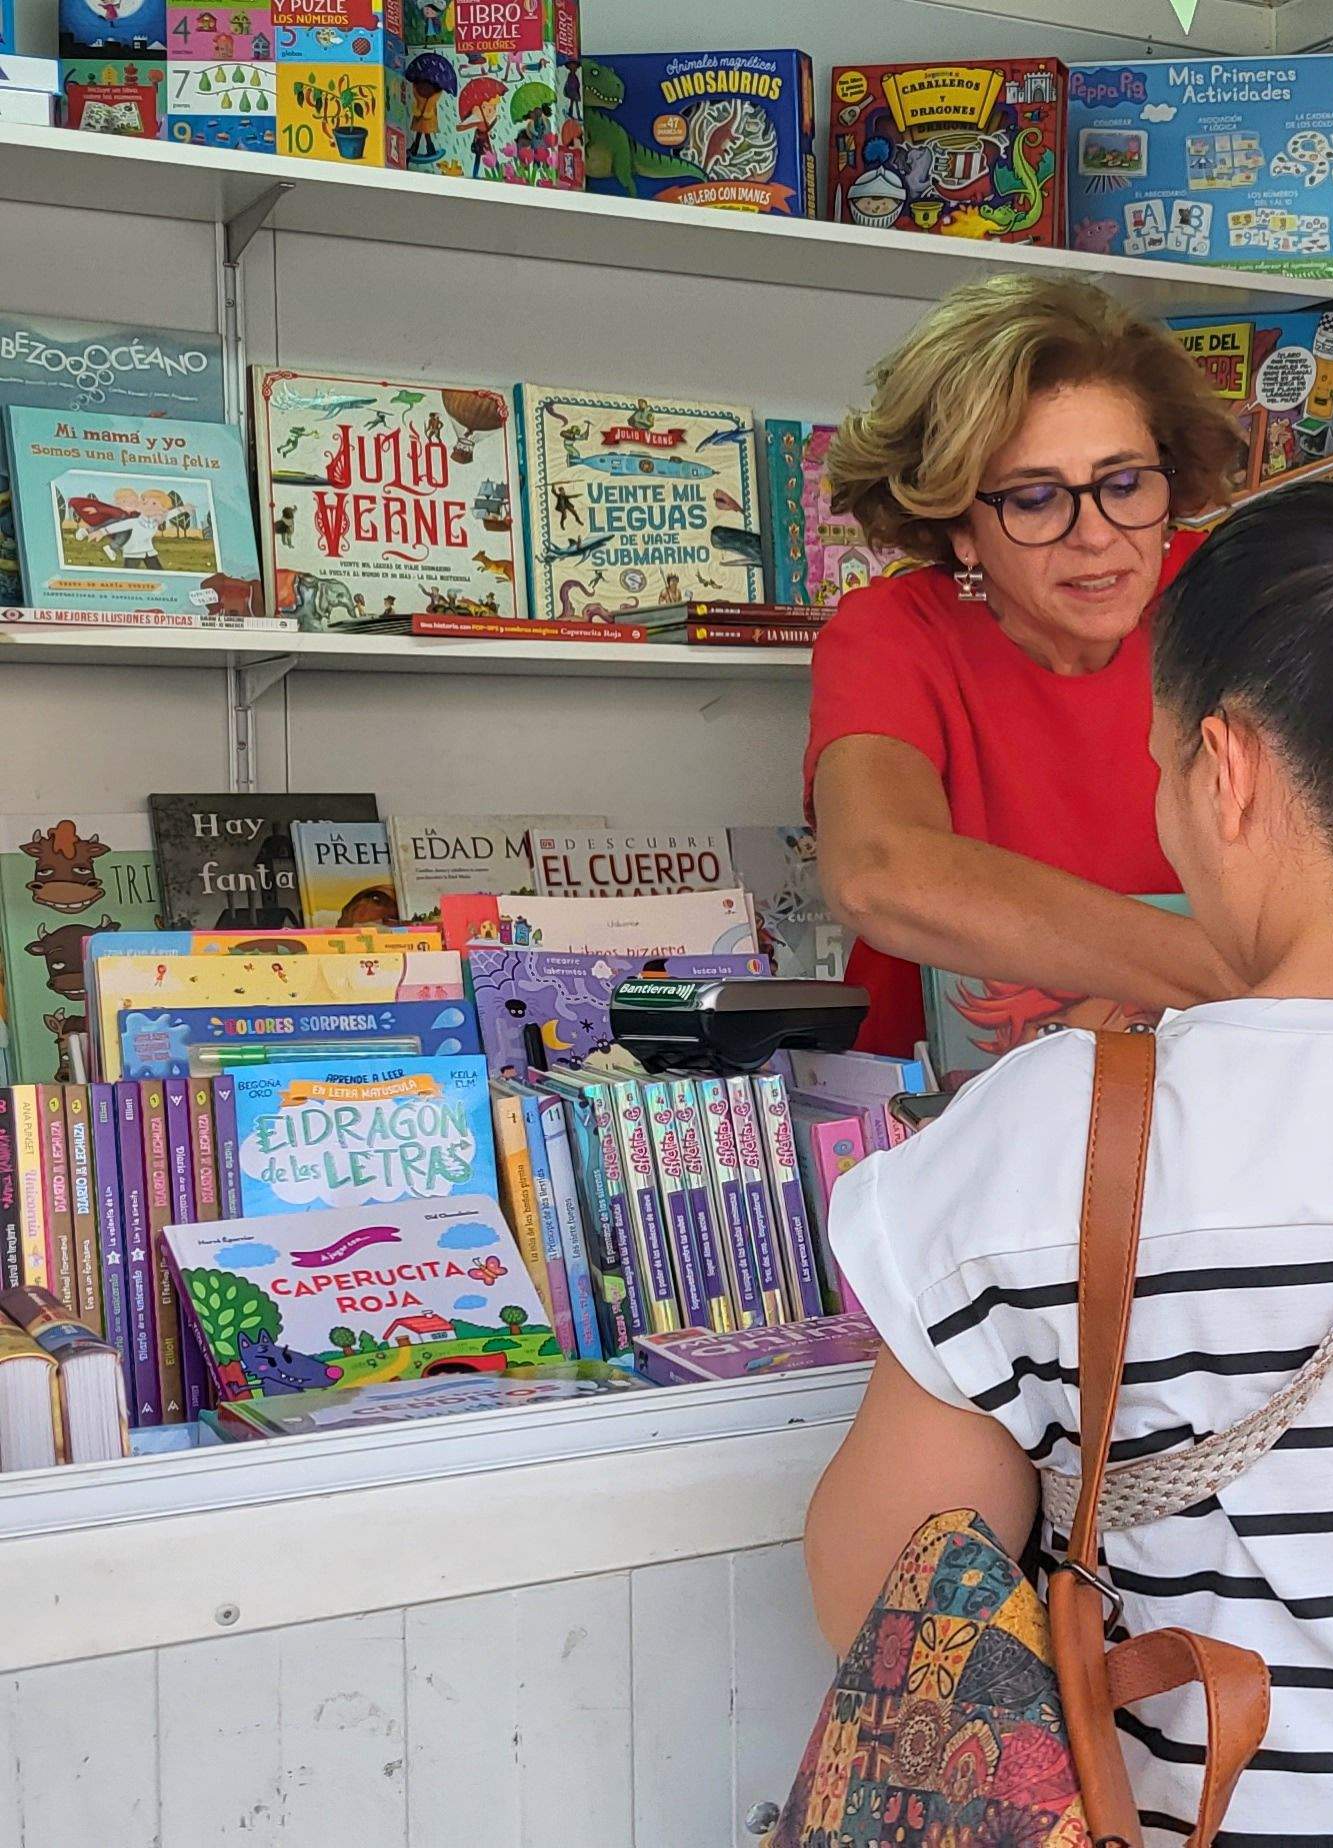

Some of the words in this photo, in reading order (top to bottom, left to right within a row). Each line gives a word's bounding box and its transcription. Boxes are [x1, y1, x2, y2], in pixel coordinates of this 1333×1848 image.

[290, 0, 348, 14] PUZLE
[457, 3, 521, 24] LIBRO
[273, 14, 294, 25] LOS
[295, 12, 349, 25] NÚMEROS
[172, 16, 191, 45] 4
[458, 26, 468, 39] Y
[472, 24, 521, 39] PUZLE
[458, 41, 475, 51] LOS
[477, 40, 516, 51] COLORES
[172, 69, 191, 99] 7
[1169, 66, 1204, 86] Mis
[1212, 65, 1297, 83] Primeras
[661, 70, 783, 103] DINOSAURIOS
[901, 78, 981, 95] CABALLEROS
[1071, 74, 1118, 103] Peppa
[1120, 73, 1146, 99] Pig
[1182, 84, 1291, 103] Actividades
[939, 95, 946, 103] Y
[910, 106, 976, 118] DRAGONES
[173, 122, 192, 144] 9
[282, 124, 314, 154] 10
[678, 187, 717, 205] TABLERO
[719, 187, 737, 202] CON
[739, 189, 772, 205] IMANES
[1209, 334, 1240, 351] DEL
[54, 423, 77, 439] Mi
[84, 429, 141, 444] mamá
[146, 436, 158, 449] y
[162, 436, 186, 450] yo
[86, 450, 114, 461] una
[120, 450, 178, 466] familia
[182, 454, 221, 471] feliz
[326, 422, 450, 497] JULIO
[587, 484, 664, 503] VEINTE
[673, 484, 706, 502] MIL
[314, 491, 469, 561] VERNE
[588, 506, 708, 533] LEGUAS
[620, 533, 639, 546] DE
[642, 533, 680, 546] VIAJE
[591, 546, 711, 567] SUBMARINO
[33, 610, 53, 621] LAS
[55, 611, 99, 624] MEJORES
[101, 612, 151, 625] ILUSIONES
[561, 627, 601, 638] Caperucita
[603, 628, 622, 639] Roja
[192, 814, 264, 839] Hay
[425, 828, 437, 837] LA
[331, 833, 344, 842] LA
[565, 836, 716, 851] DESCUBRE
[413, 837, 493, 860] EDAD
[543, 854, 581, 886] EL
[589, 851, 720, 884] CUERPO
[111, 864, 154, 904] TRI
[620, 983, 676, 997] Bantierra
[225, 1015, 294, 1034] COLORES
[300, 1015, 378, 1032] SORPRESA
[238, 1079, 282, 1091] BEGOÑA
[325, 1073, 369, 1083] APRENDE
[382, 1069, 404, 1082] LEER
[249, 1087, 273, 1098] ORO
[313, 1085, 326, 1095] EN
[329, 1086, 358, 1098] LETRA
[261, 1157, 287, 1183] de
[323, 1140, 473, 1190] LETRAS
[270, 1261, 466, 1298] CAPERUCITA
[336, 1290, 423, 1314] ROJA
